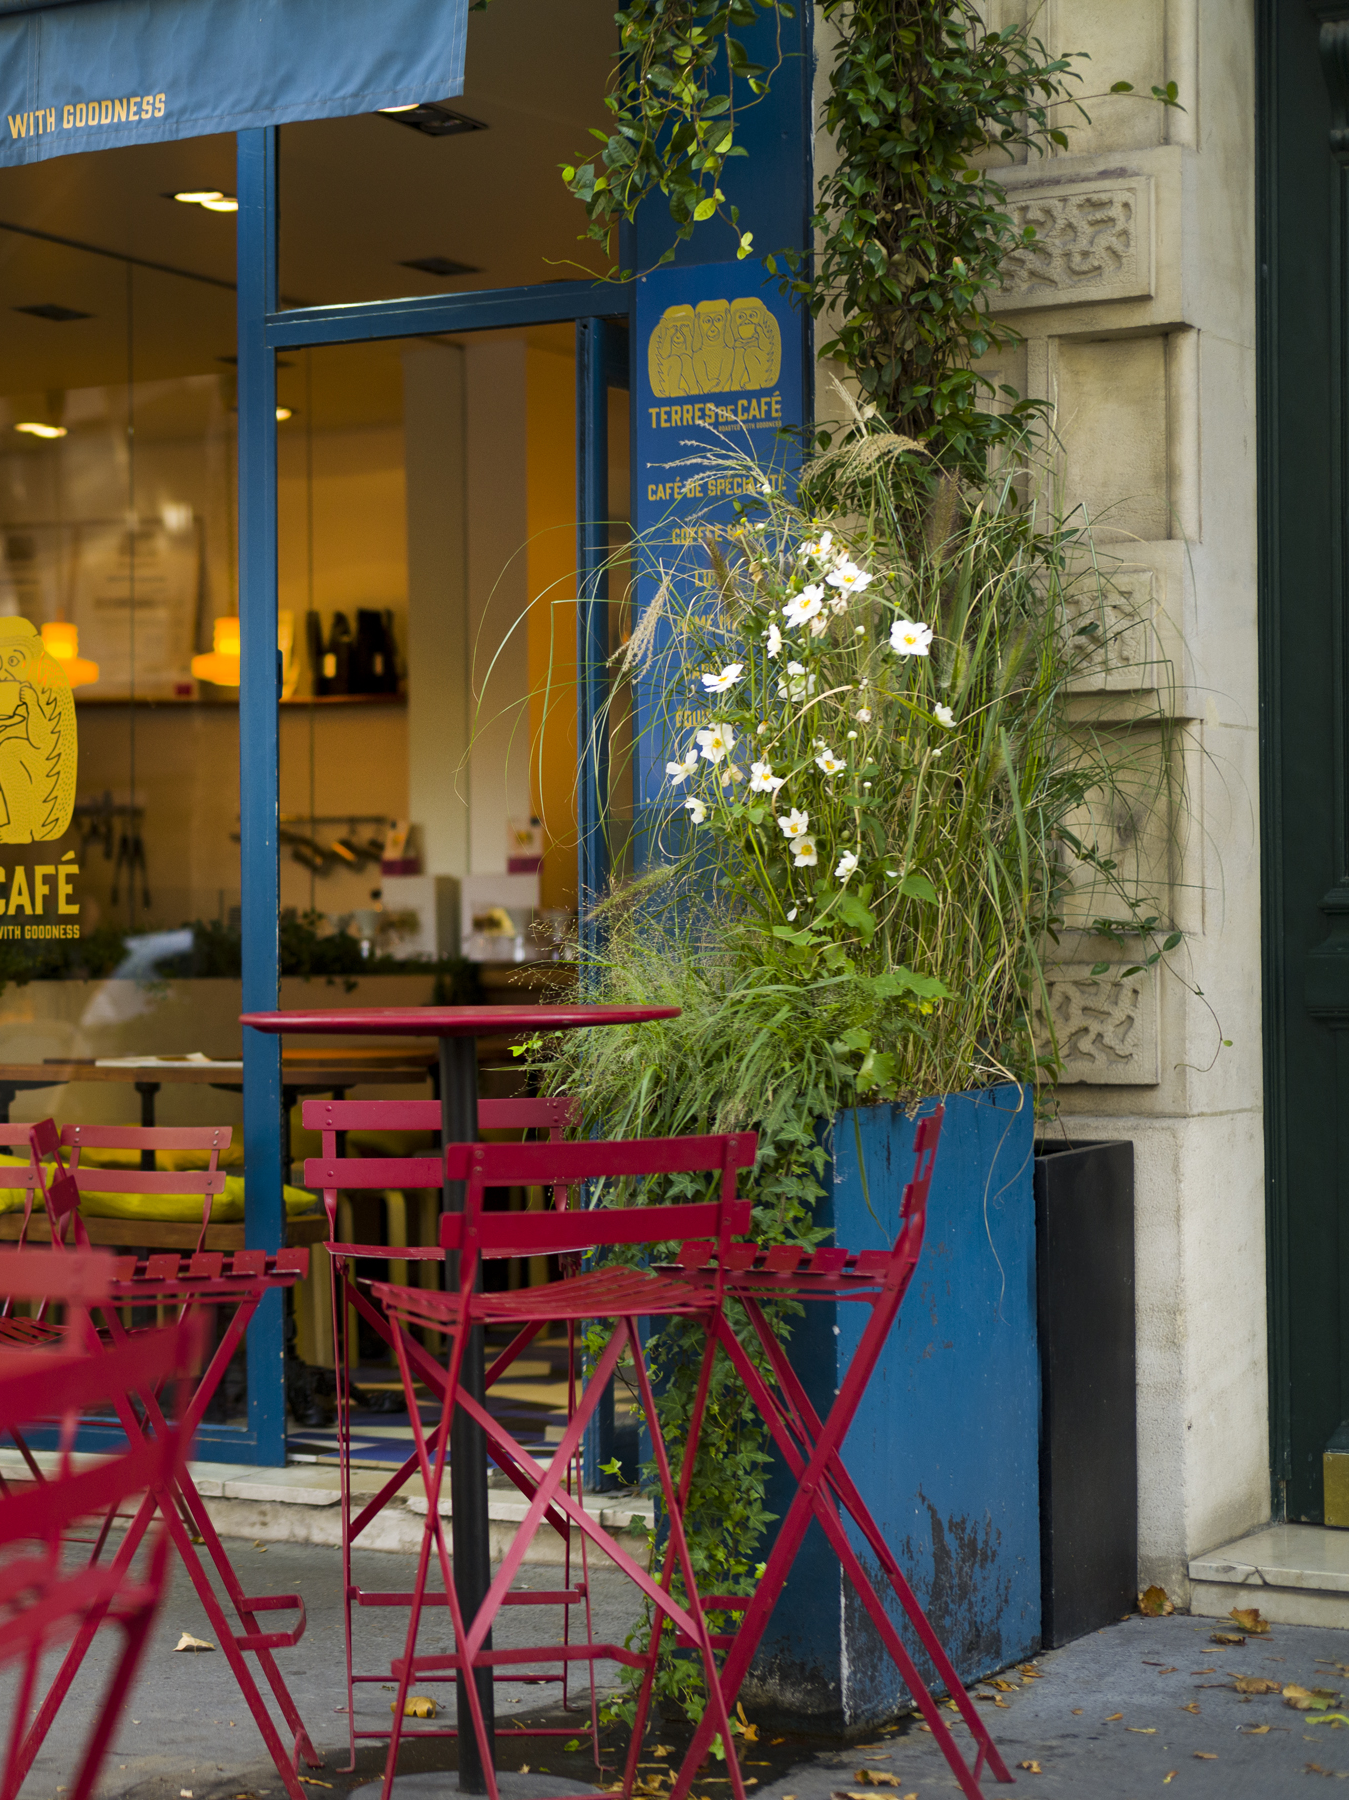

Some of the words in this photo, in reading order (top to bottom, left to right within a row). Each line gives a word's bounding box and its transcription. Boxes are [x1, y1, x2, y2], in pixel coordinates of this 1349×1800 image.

[7, 107, 55, 139] WITH
[62, 92, 166, 129] GOODNESS
[648, 402, 716, 429] TERRES
[737, 391, 782, 421] CAFÉ
[648, 476, 683, 501] CAFÉ
[686, 479, 704, 498] DE
[24, 925, 80, 939] GOODNESS
